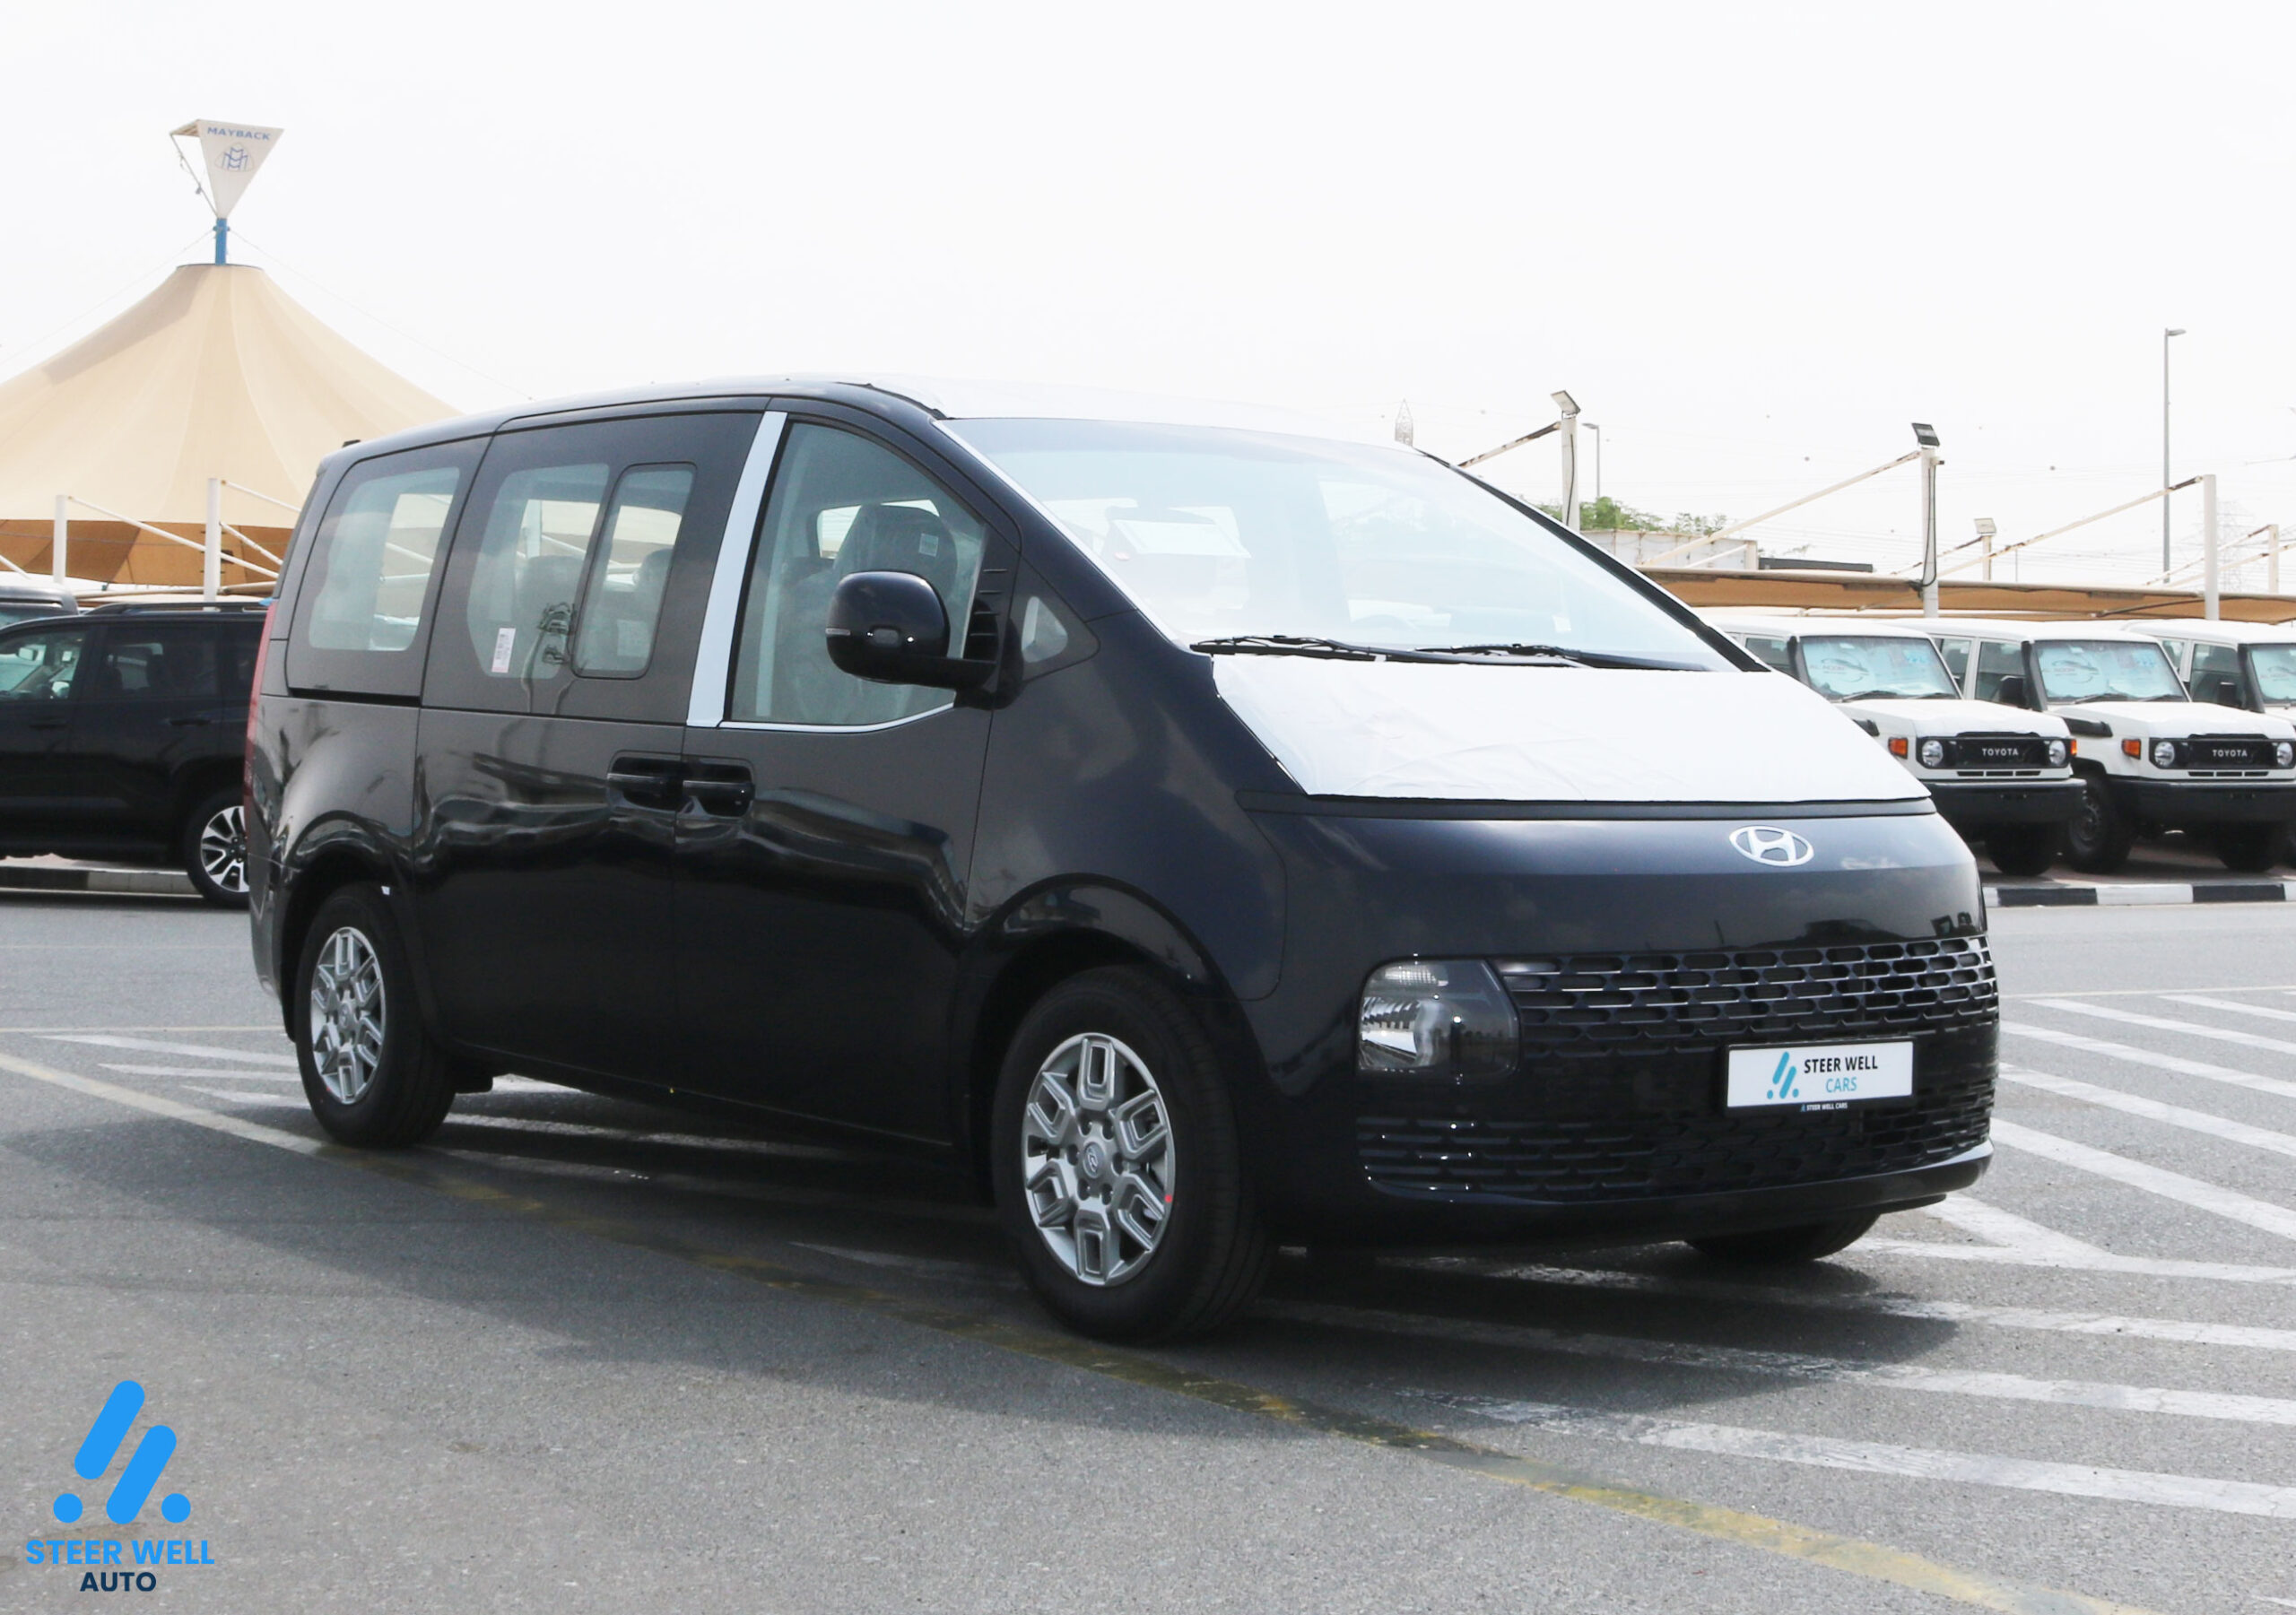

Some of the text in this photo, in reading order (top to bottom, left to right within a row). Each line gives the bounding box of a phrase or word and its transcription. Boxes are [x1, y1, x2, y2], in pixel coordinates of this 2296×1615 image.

[207, 126, 271, 140] MAYBACK
[1982, 748, 2019, 756] TOYOTA
[1804, 1055, 1879, 1073] STEER WELL
[1825, 1077, 1857, 1093] CARS
